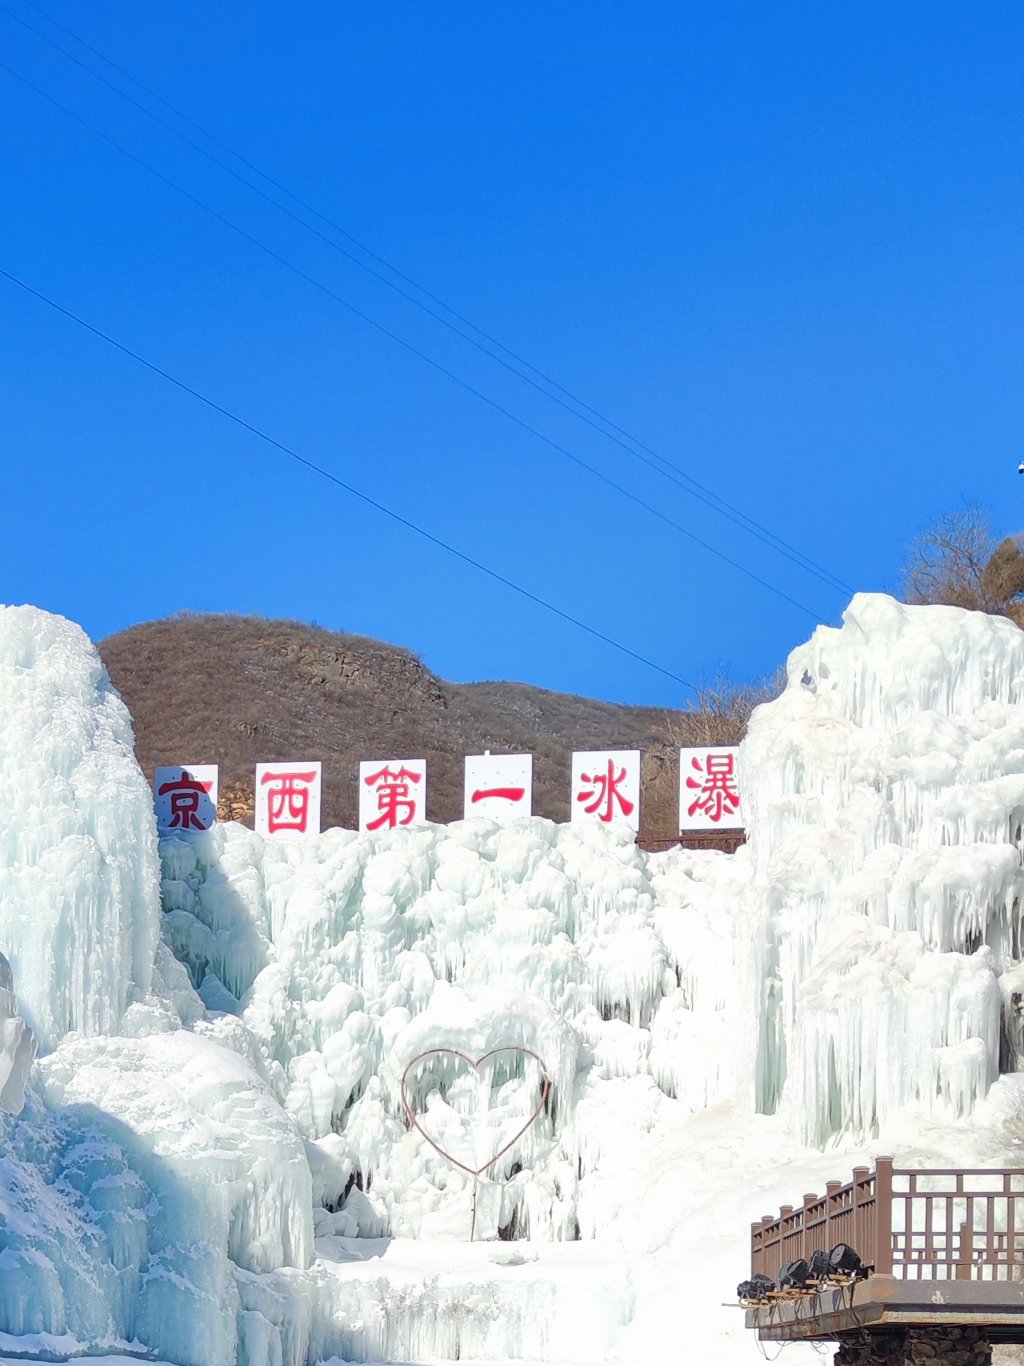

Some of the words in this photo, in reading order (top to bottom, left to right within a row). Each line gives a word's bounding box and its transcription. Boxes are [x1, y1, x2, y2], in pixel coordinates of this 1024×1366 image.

[159, 753, 740, 834] 京西第一冰瀑
